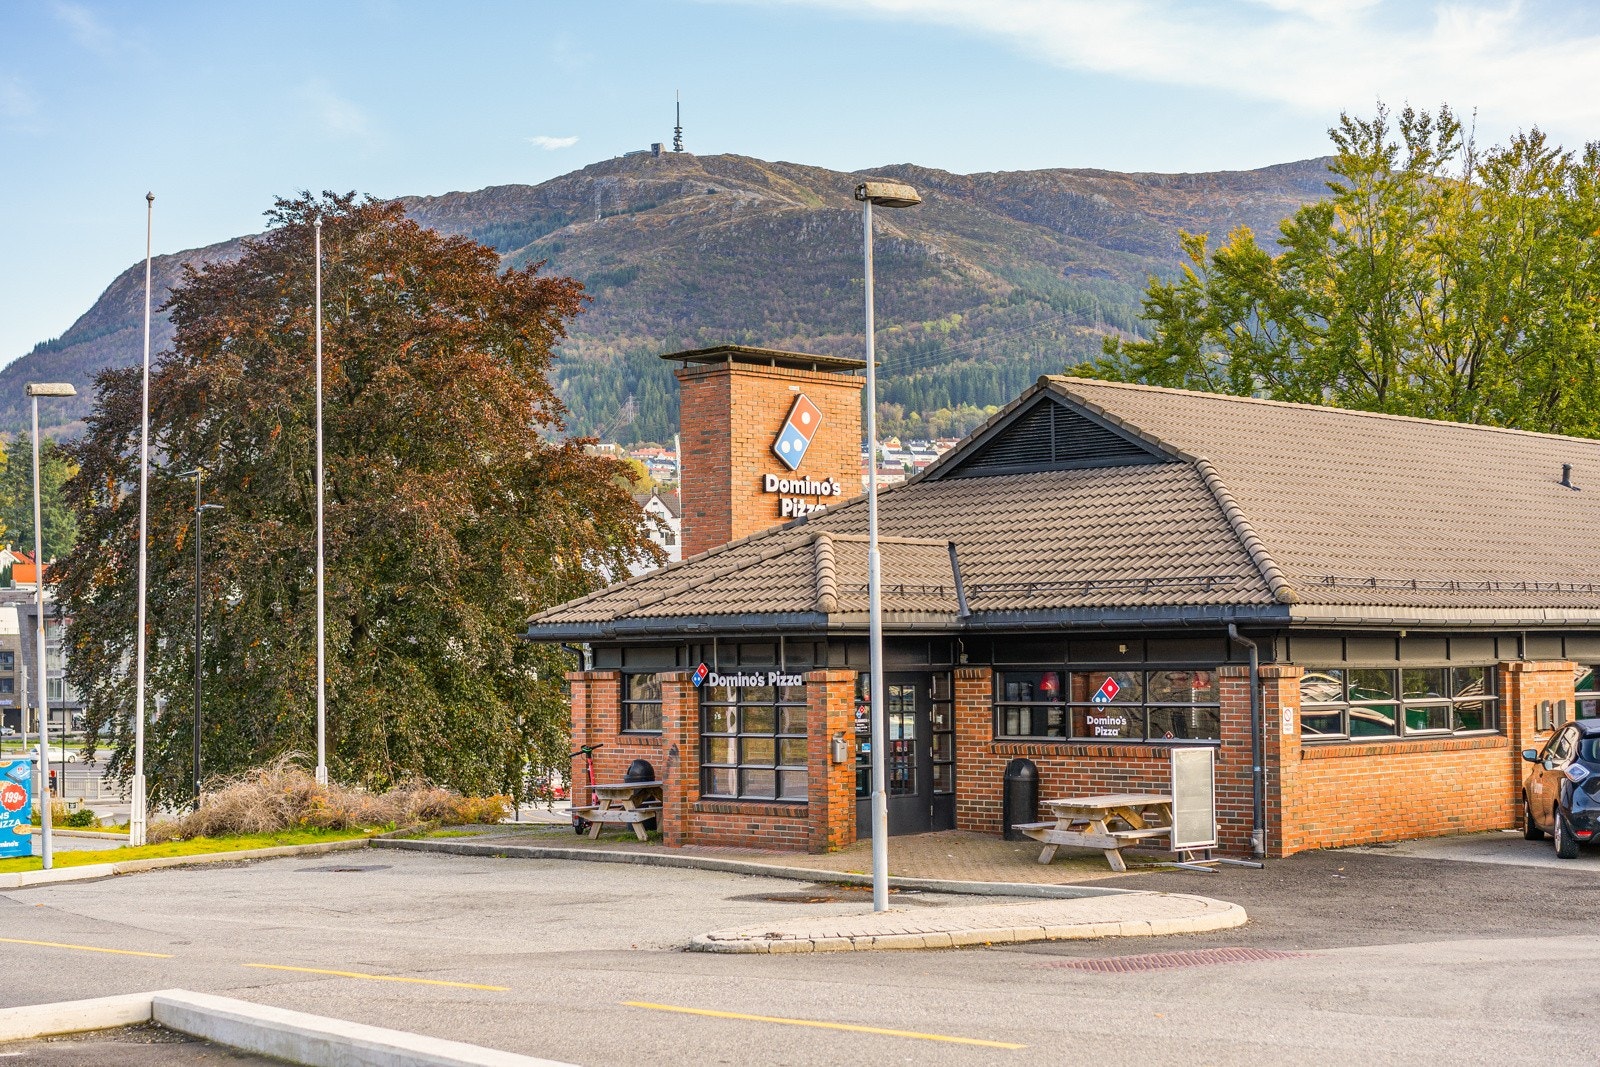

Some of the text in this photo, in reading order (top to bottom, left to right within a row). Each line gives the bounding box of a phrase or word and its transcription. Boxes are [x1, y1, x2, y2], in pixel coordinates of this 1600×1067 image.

[765, 474, 841, 496] Domino's
[709, 670, 803, 687] Domino's Pizza
[1086, 716, 1127, 725] Domino's
[1095, 726, 1120, 736] Pizza
